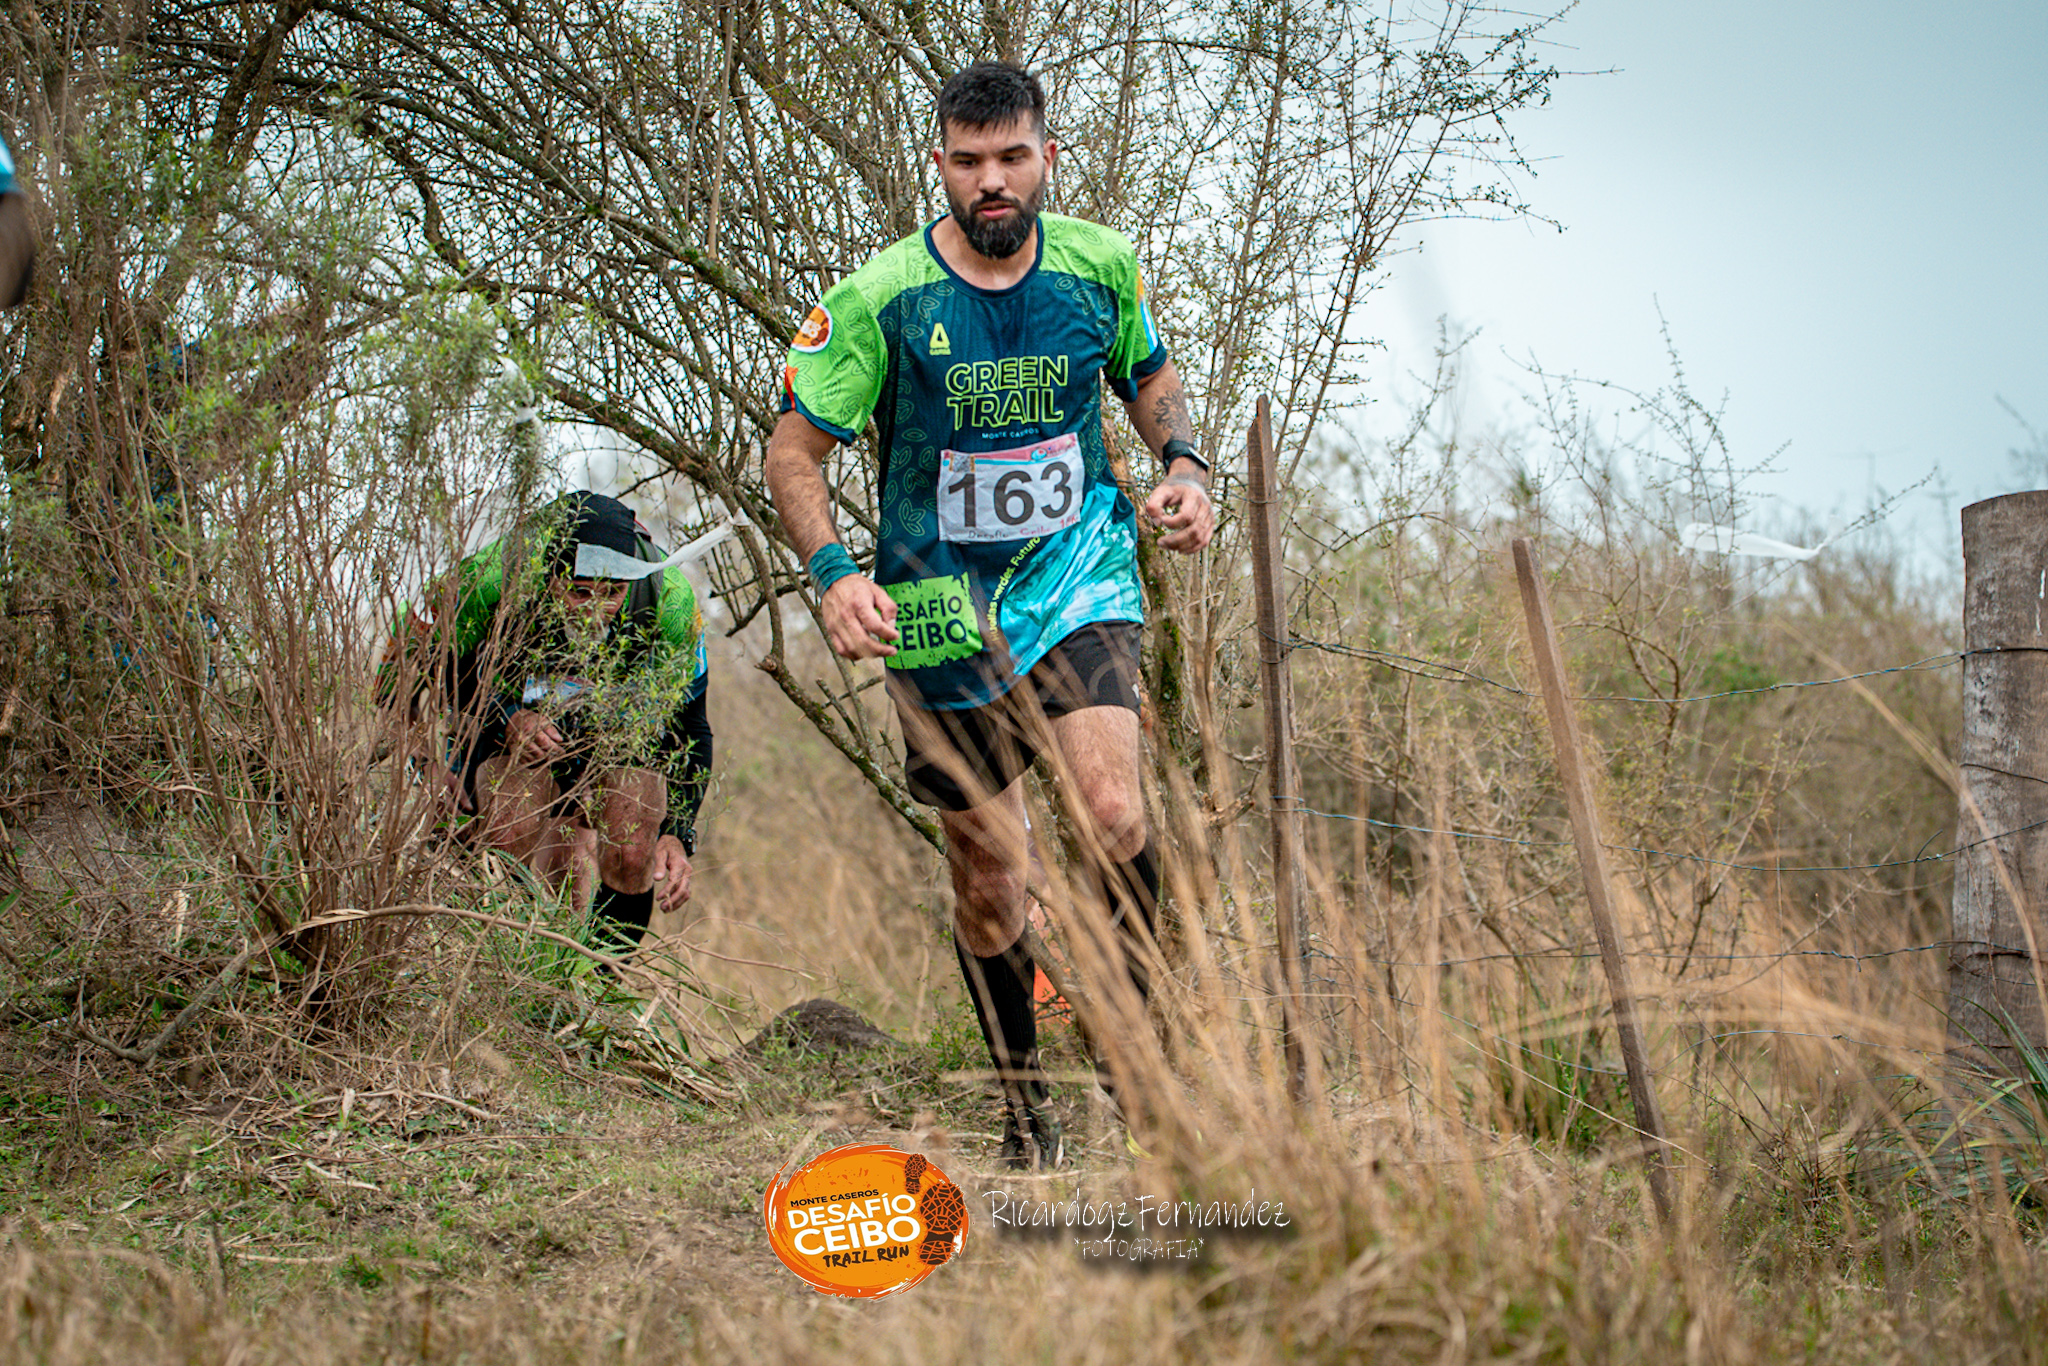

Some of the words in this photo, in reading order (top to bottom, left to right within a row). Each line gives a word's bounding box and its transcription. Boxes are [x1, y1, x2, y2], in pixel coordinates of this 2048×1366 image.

[945, 355, 1068, 396] GREEN
[946, 388, 1064, 430] TRAIL
[948, 461, 1072, 528] 163
[1010, 536, 1041, 566] Futuro
[896, 592, 962, 621] ESAFÍO
[893, 618, 967, 651] EIBO
